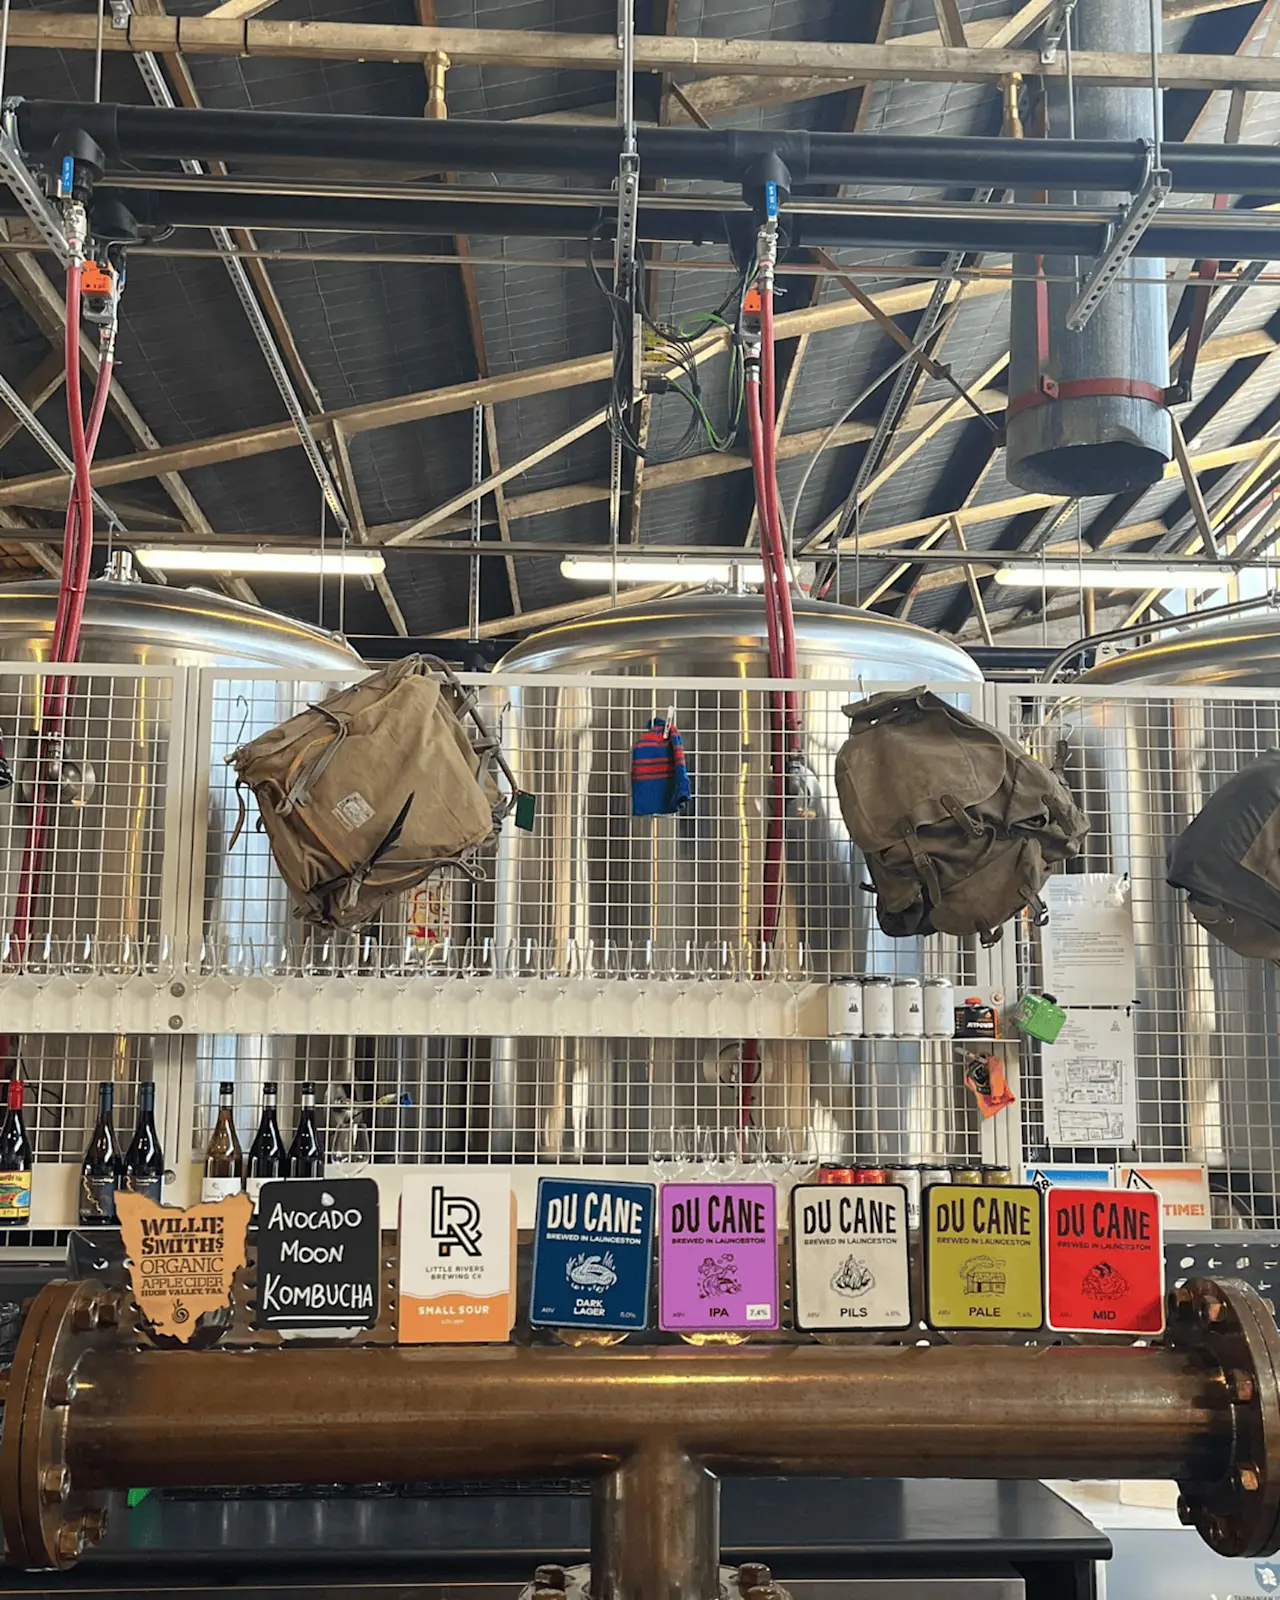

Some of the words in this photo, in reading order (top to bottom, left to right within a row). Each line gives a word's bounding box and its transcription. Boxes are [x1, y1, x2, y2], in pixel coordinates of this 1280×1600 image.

[267, 1202, 363, 1231] AVOCADO
[547, 1193, 578, 1230] DU
[583, 1191, 643, 1234] CANE
[672, 1197, 700, 1233] DU
[708, 1194, 765, 1233] CANE
[803, 1199, 831, 1234] DU
[839, 1196, 896, 1234] CANE
[937, 1198, 965, 1233] DU
[973, 1196, 1030, 1235] CANE
[1163, 1203, 1205, 1217] TIME!
[140, 1216, 224, 1236] WILLIE
[1056, 1203, 1085, 1237] DU
[1093, 1201, 1150, 1240] CANE
[546, 1232, 579, 1241] BREWED
[580, 1234, 589, 1242] IN
[589, 1235, 642, 1245] LAUNCESTON
[980, 1238, 1031, 1246] LAUNCESTON
[280, 1239, 344, 1264] MOON
[140, 1257, 224, 1275] ORGANIC
[455, 1265, 485, 1273] RIVERS
[141, 1278, 183, 1289] APPLE
[184, 1276, 224, 1287] CIDER
[262, 1272, 374, 1311] KOMBUCHA
[458, 1304, 490, 1315] SOUR
[576, 1299, 603, 1308] DARK
[573, 1307, 605, 1316] LAGER
[709, 1308, 729, 1317] IPA
[840, 1307, 868, 1318] PILS
[969, 1307, 1001, 1317] PALE
[1093, 1310, 1117, 1320] MID
